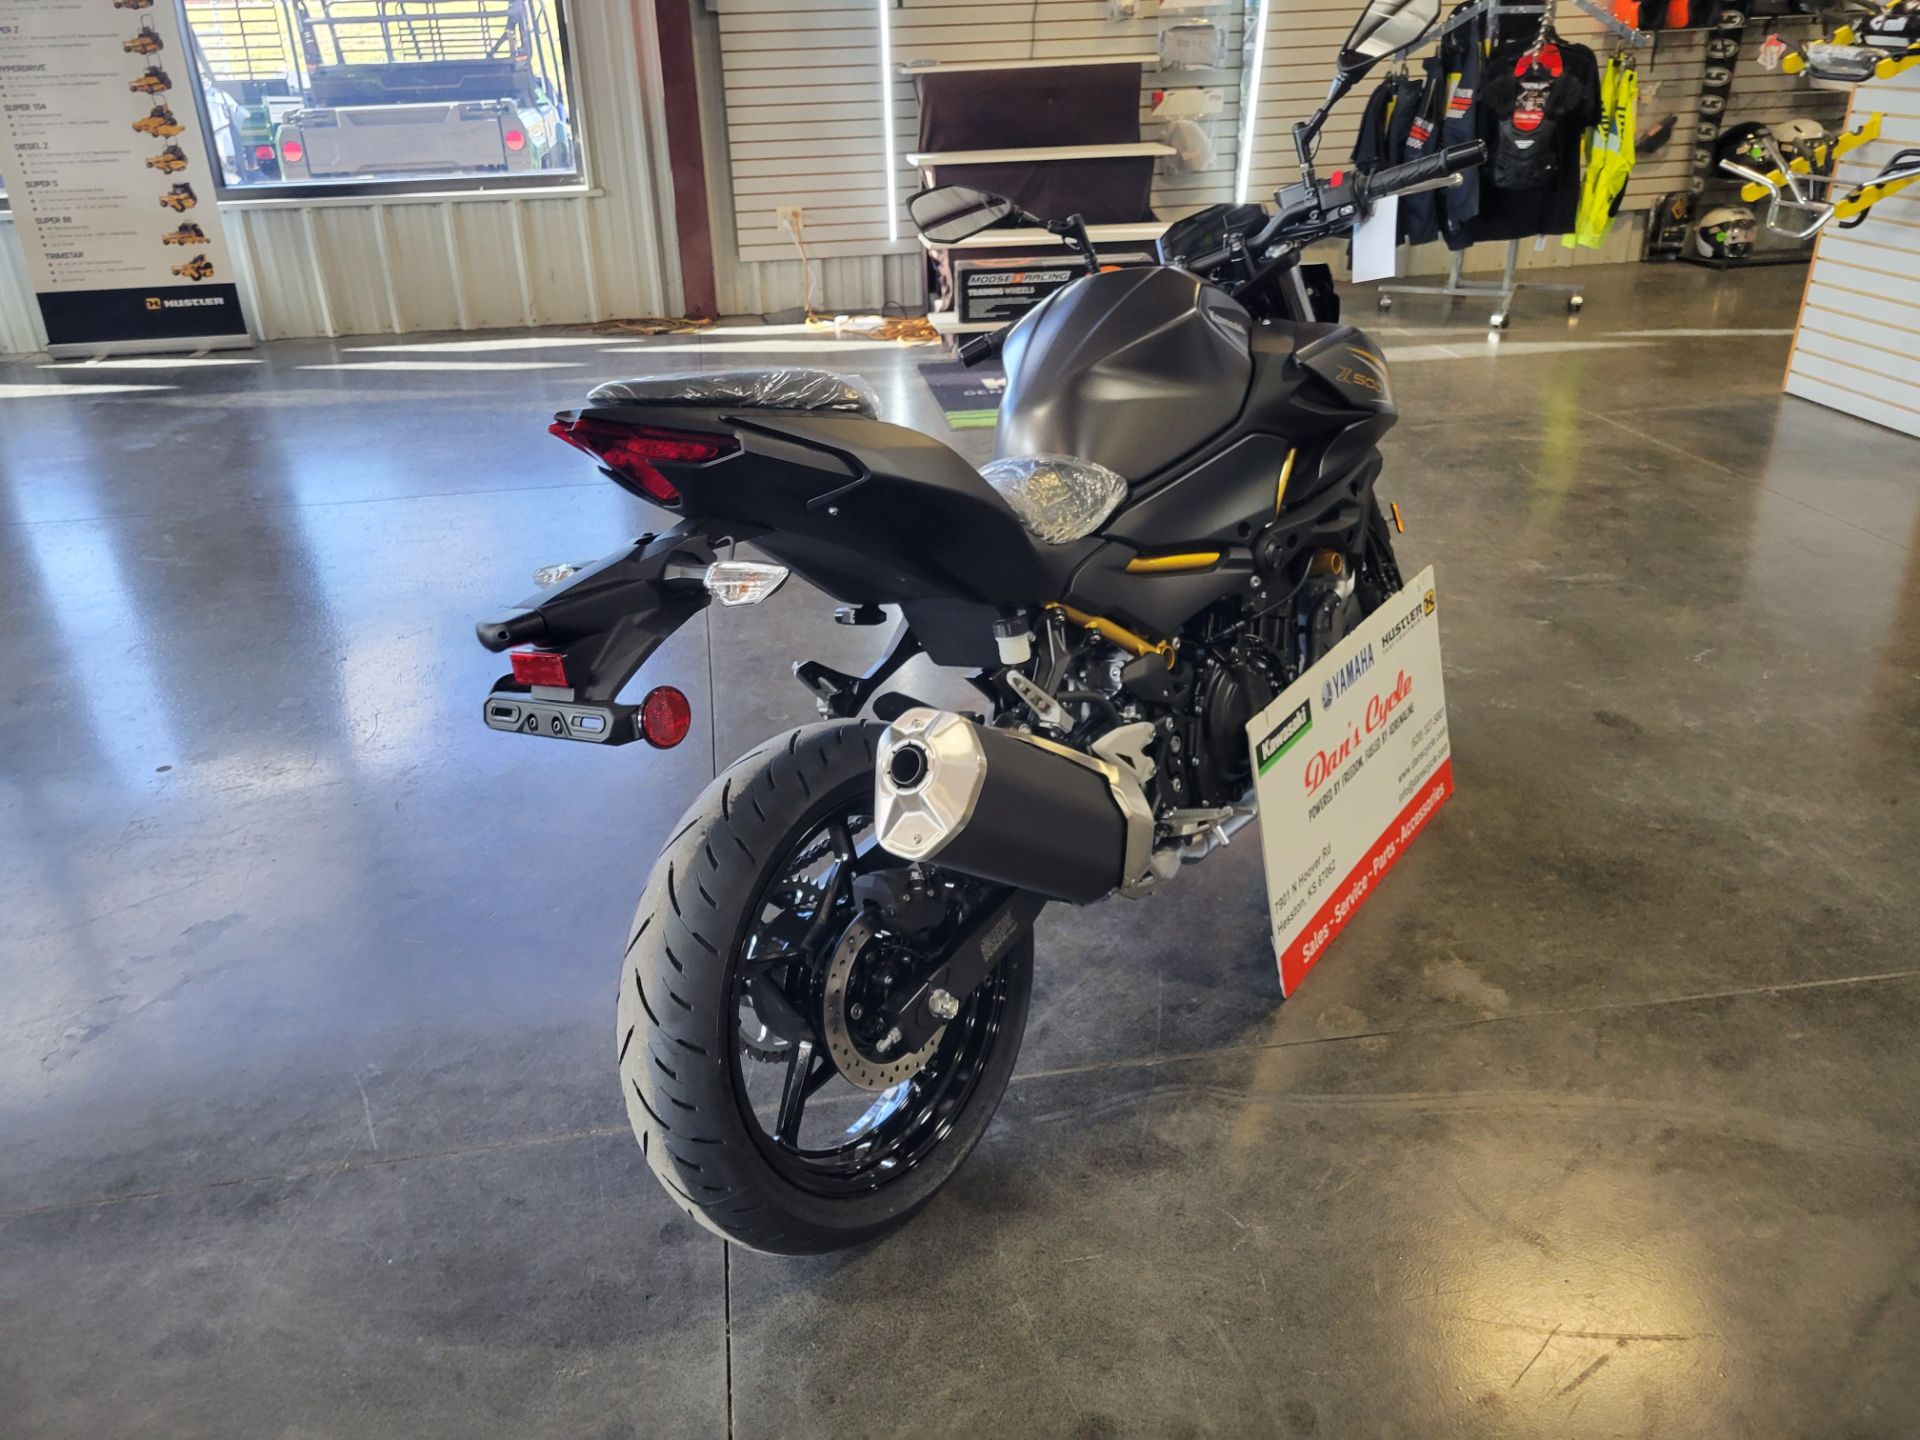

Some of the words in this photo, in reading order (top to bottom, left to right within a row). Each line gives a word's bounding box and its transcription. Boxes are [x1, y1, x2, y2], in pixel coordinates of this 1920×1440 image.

[163, 297, 224, 308] HUSTLER
[971, 275, 1012, 284] MOOSE
[1024, 272, 1069, 281] RACING
[1381, 603, 1423, 648] HUSTLER
[1332, 643, 1375, 699] YAMAHA
[1261, 705, 1308, 761] Kawasaki
[1304, 720, 1361, 798] Dan's
[1365, 669, 1413, 735] Cycle
[1308, 788, 1333, 824] POWERED
[1333, 781, 1342, 797] BY
[1365, 737, 1381, 763] FUELED
[1389, 701, 1415, 736] ADRENALINE
[1275, 888, 1291, 915] 7901
[1298, 854, 1321, 888] Hoover
[1322, 840, 1332, 860] Rd
[1302, 923, 1330, 964] Sales
[1334, 874, 1369, 923] Service
[1372, 841, 1396, 877] Parts
[1400, 782, 1446, 844] Accessories
[1307, 880, 1318, 900] KS
